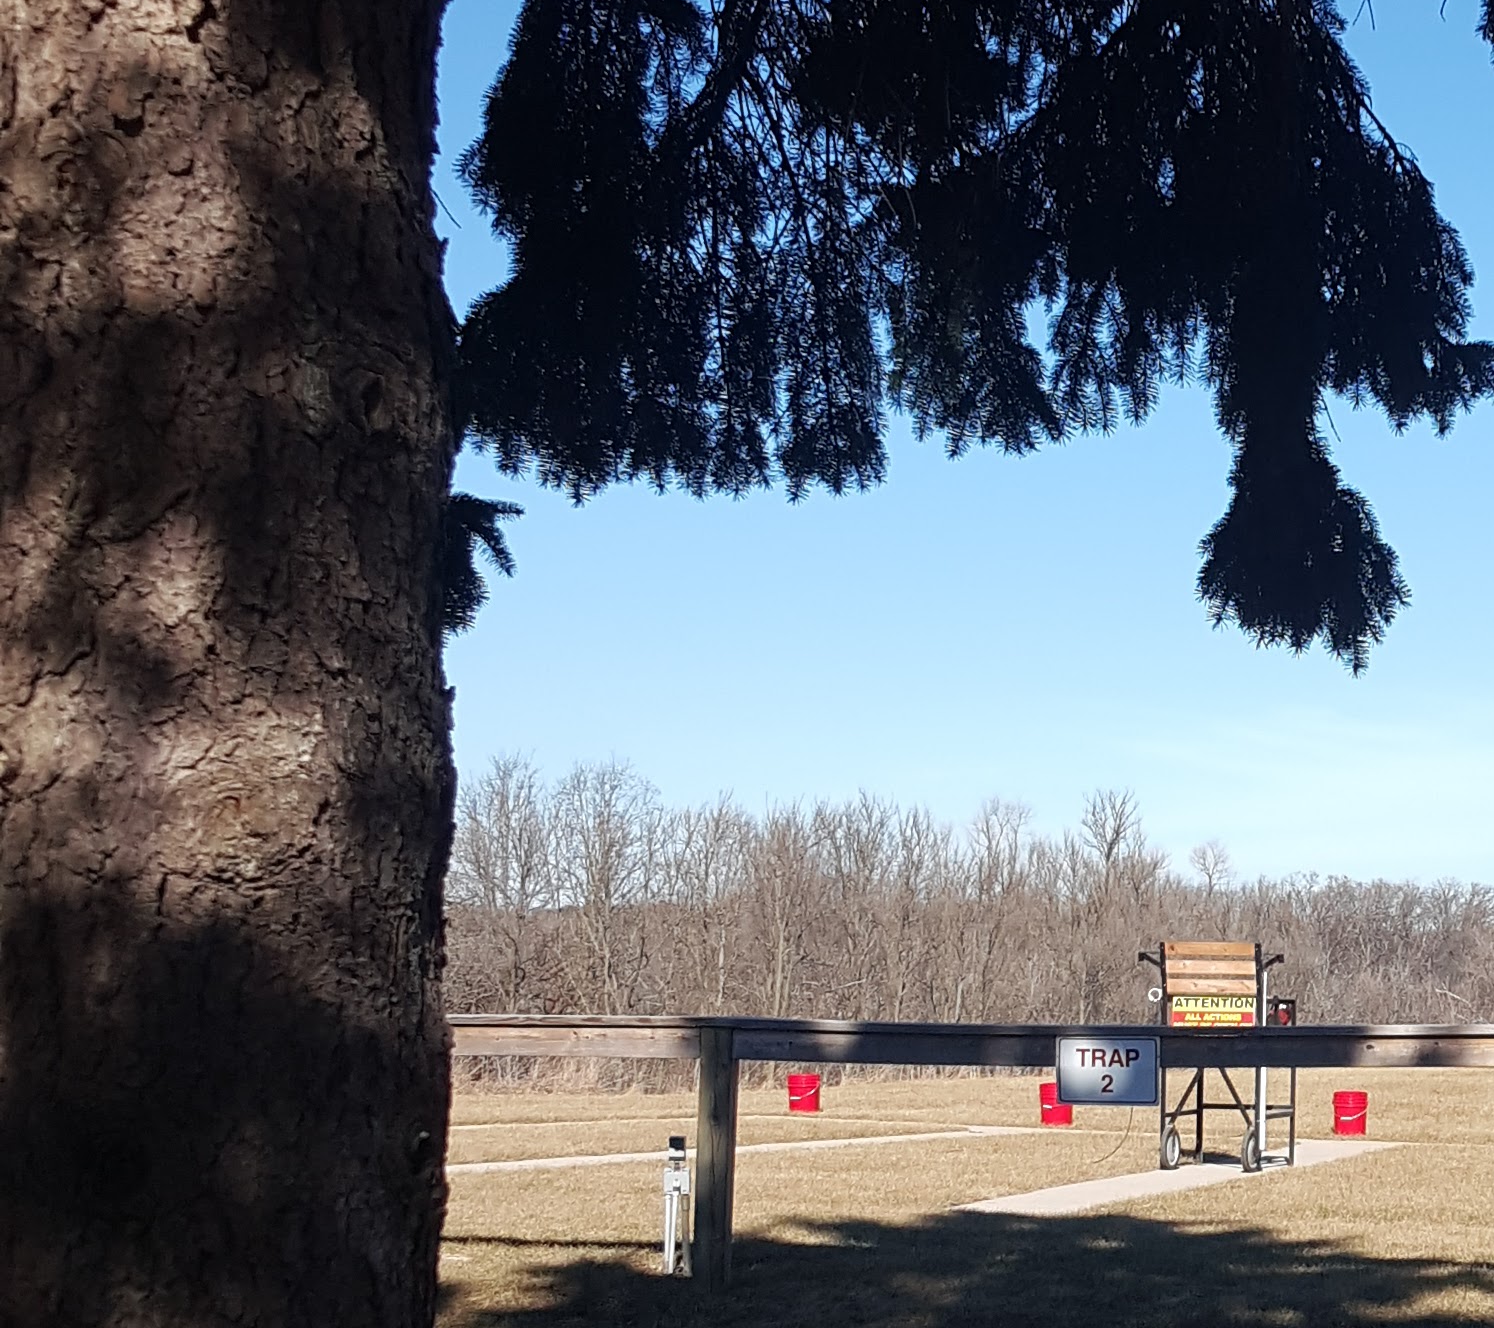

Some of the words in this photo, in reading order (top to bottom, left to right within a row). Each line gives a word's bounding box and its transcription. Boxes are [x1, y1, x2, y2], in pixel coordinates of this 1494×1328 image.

[1174, 997, 1255, 1008] ATTENTION
[1184, 1013, 1202, 1021] ALL
[1203, 1013, 1242, 1021] ACTIONS
[1076, 1048, 1140, 1067] TRAP
[1101, 1074, 1114, 1093] 2
